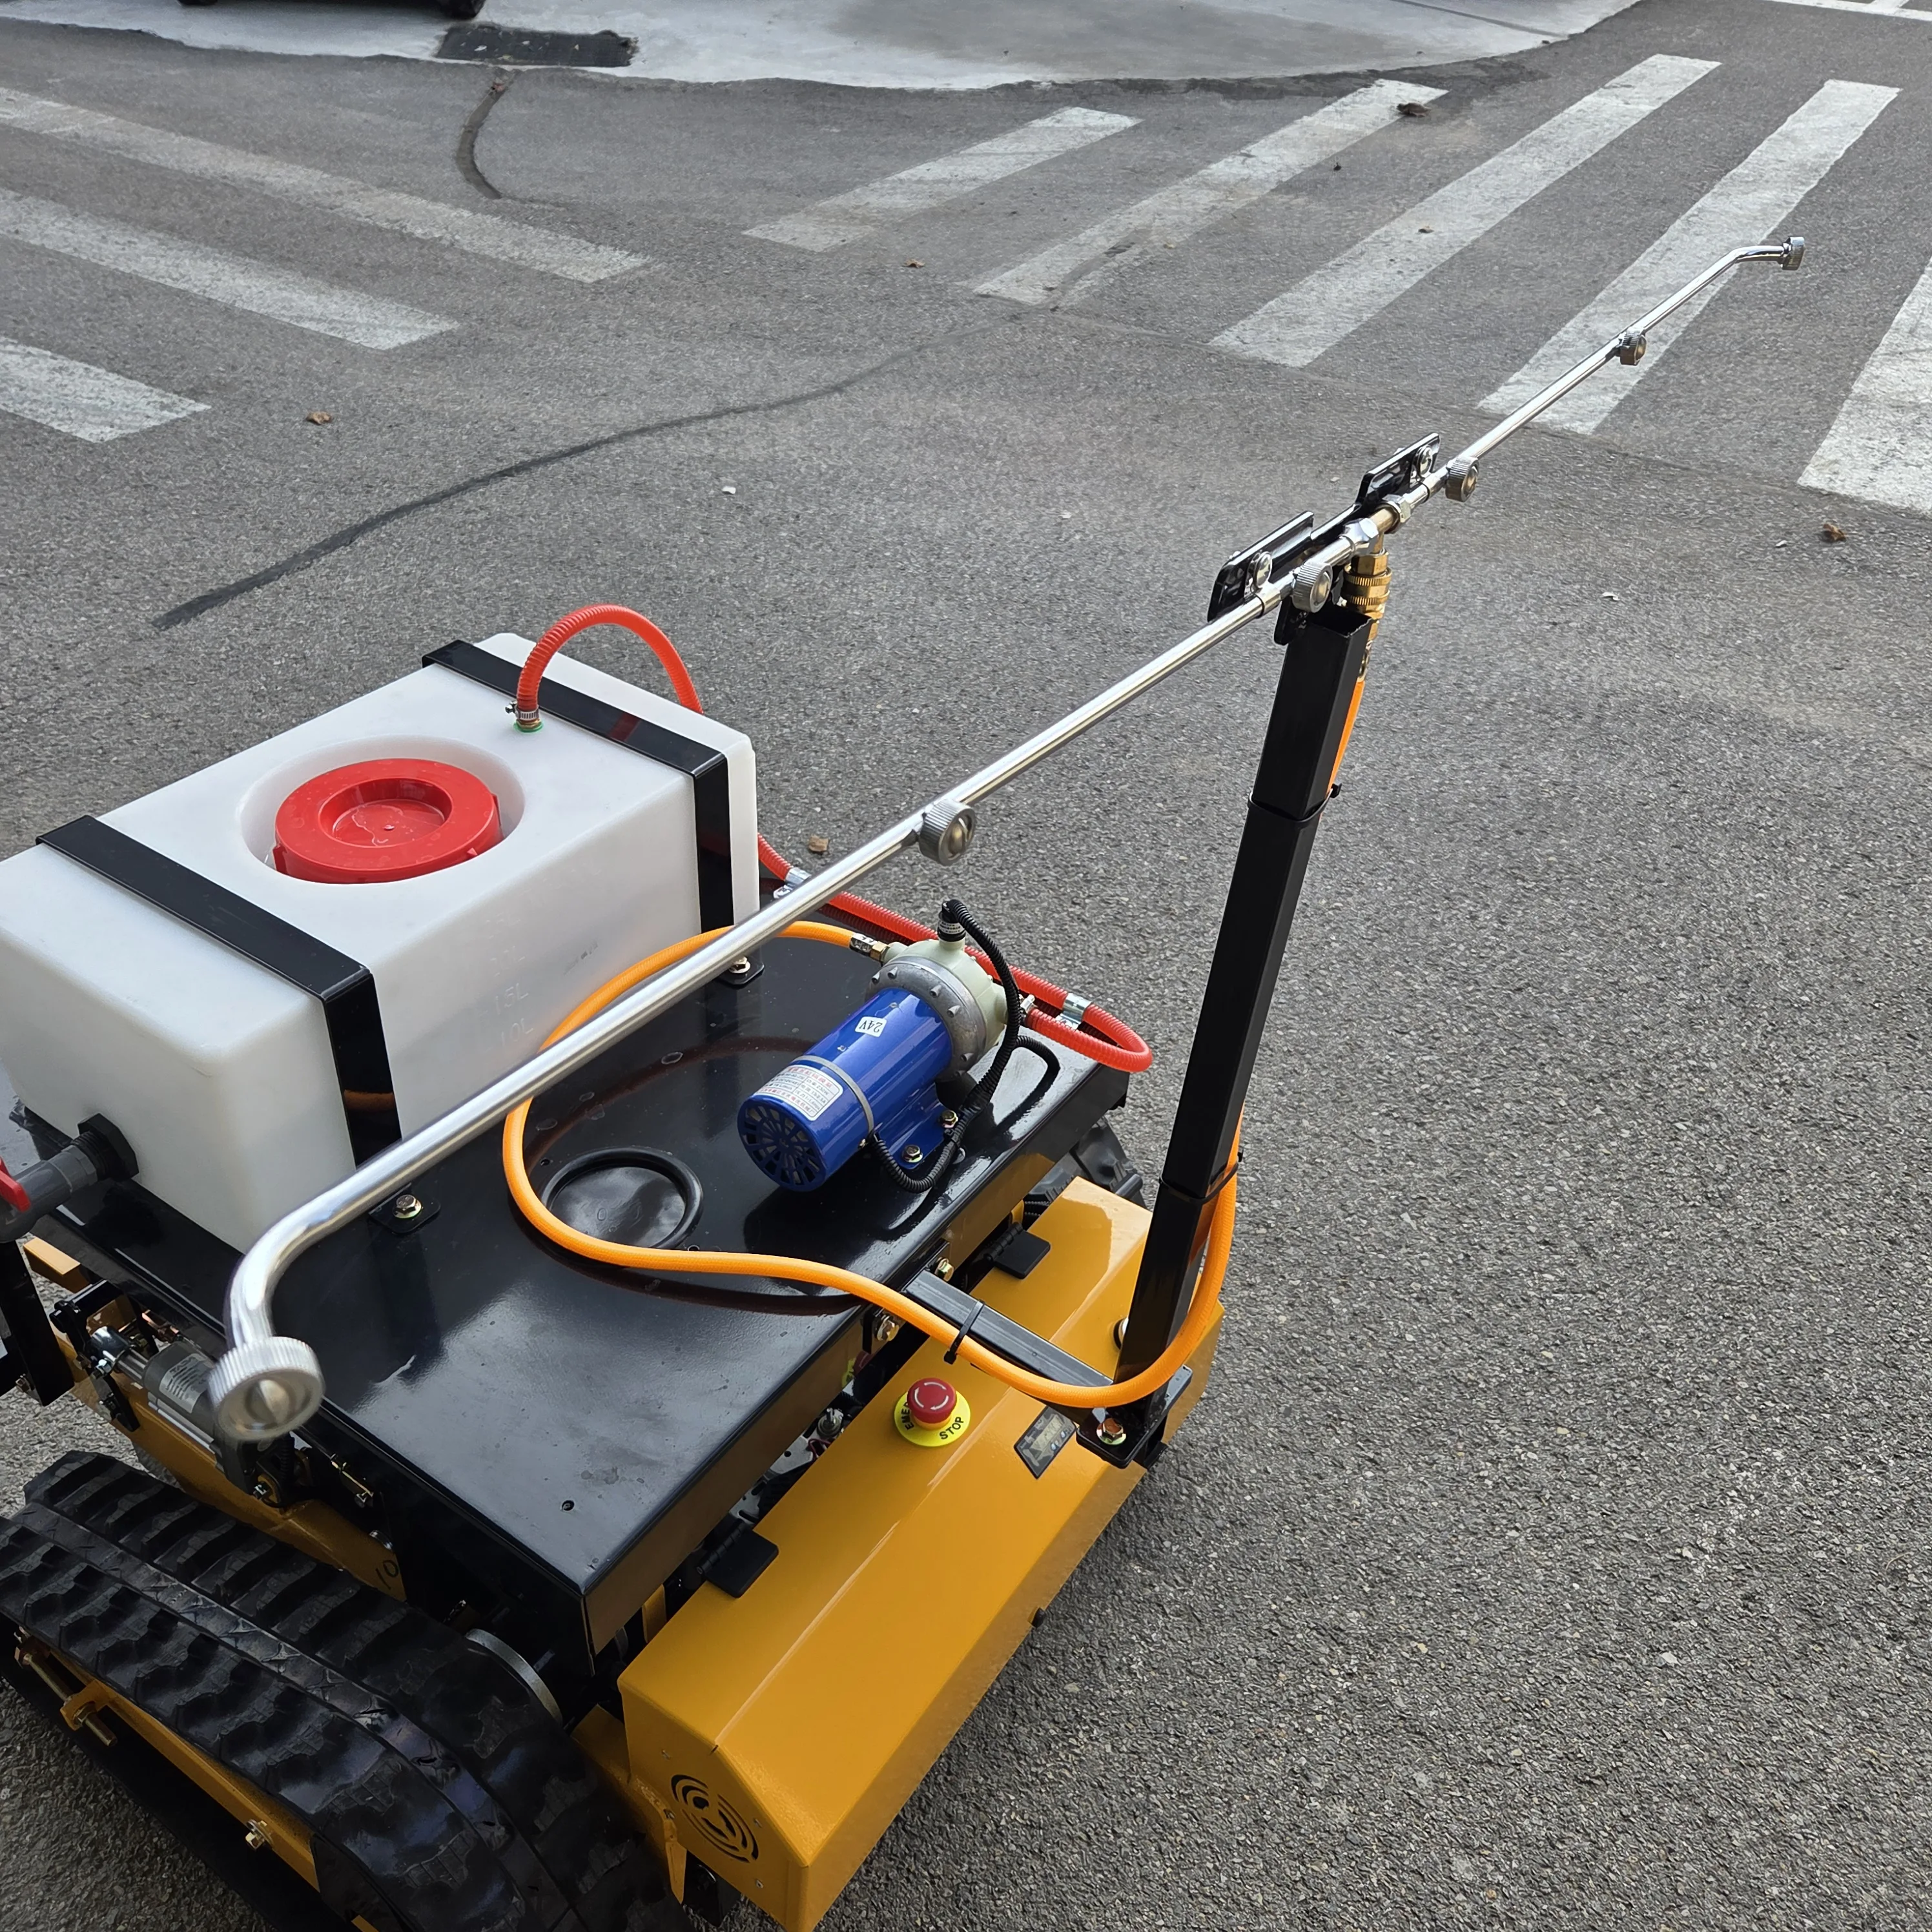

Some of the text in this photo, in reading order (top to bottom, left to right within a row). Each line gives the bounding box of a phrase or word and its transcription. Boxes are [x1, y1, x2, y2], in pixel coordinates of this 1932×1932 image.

[495, 982, 529, 1016] 15L
[500, 1017, 535, 1047] 10L
[859, 1020, 883, 1033] 24V
[939, 1416, 964, 1440] STOP
[375, 1559, 399, 1590] 10
